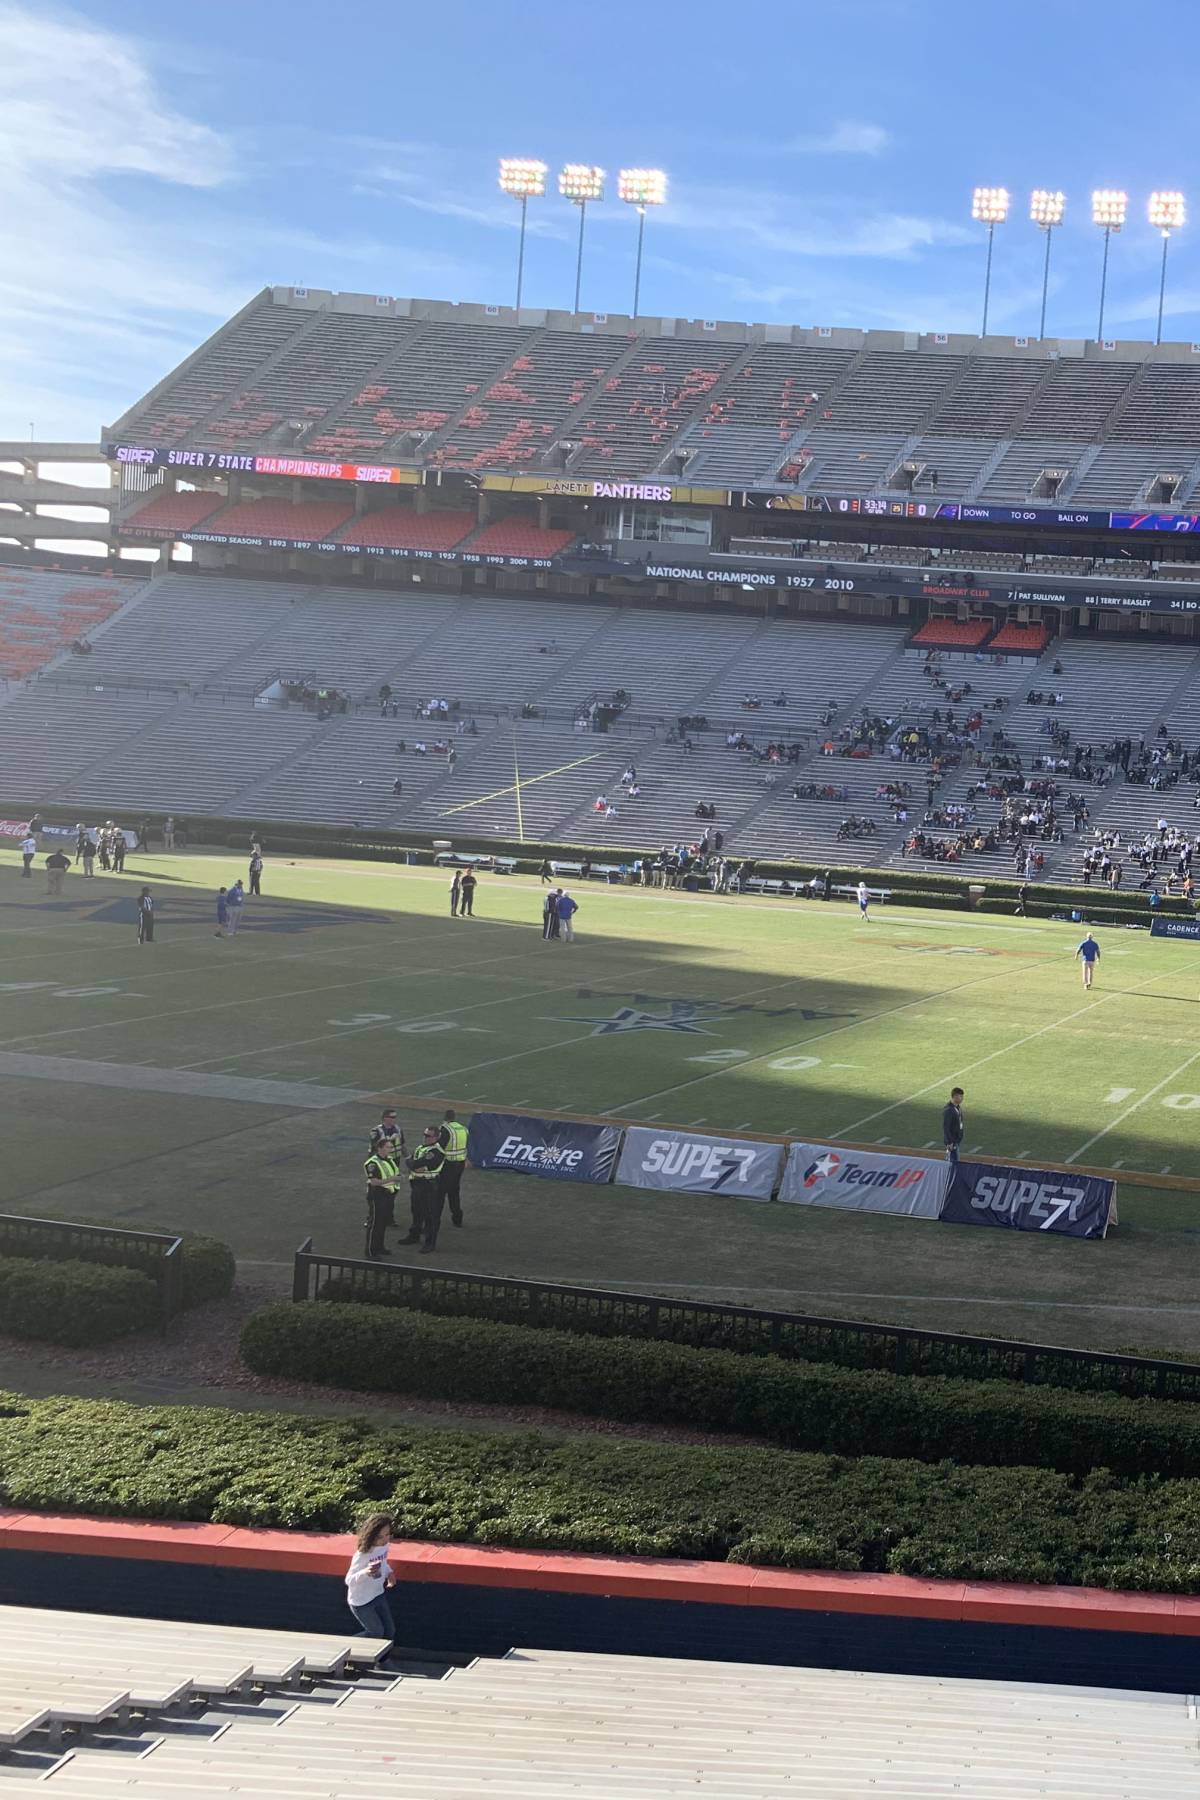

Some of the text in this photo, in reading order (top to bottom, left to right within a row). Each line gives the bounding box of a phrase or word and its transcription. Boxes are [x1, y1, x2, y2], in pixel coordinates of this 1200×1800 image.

[116, 447, 155, 463] SUPER
[168, 450, 342, 477] SUPER 7 STATE CHAMPIONSHIPS
[355, 467, 392, 483] SUPER
[545, 482, 672, 501] LANETT PANTHERS
[839, 500, 848, 511] 0
[864, 500, 887, 510] 33:14
[918, 504, 926, 516] 0
[964, 508, 989, 517] DOWN
[1011, 511, 1036, 520] TO GO
[1058, 513, 1088, 523] BALL ON
[182, 533, 227, 543] UNDEFEATED
[228, 537, 262, 546] SEASONS
[268, 539, 286, 548] 1893
[293, 541, 311, 549] 1897
[318, 543, 336, 551] 1900
[342, 545, 360, 553] 1904
[366, 547, 385, 555] 1913
[439, 552, 456, 560] 1957
[463, 554, 480, 562] 1958
[486, 556, 504, 564] 1993
[510, 558, 528, 566] 2004
[533, 559, 552, 567] 2010
[646, 566, 854, 591] NATIONAL CHAMPIONS 1957 2010
[922, 586, 990, 597] BROADWAY CLUB
[1032, 594, 1065, 602] SULLIVAN
[1085, 596, 1094, 604] 88
[1122, 599, 1151, 607] BEASLEY
[1167, 924, 1199, 933] CADENCE
[684, 1049, 822, 1070] 20
[838, 1163, 925, 1189] TeamIP
